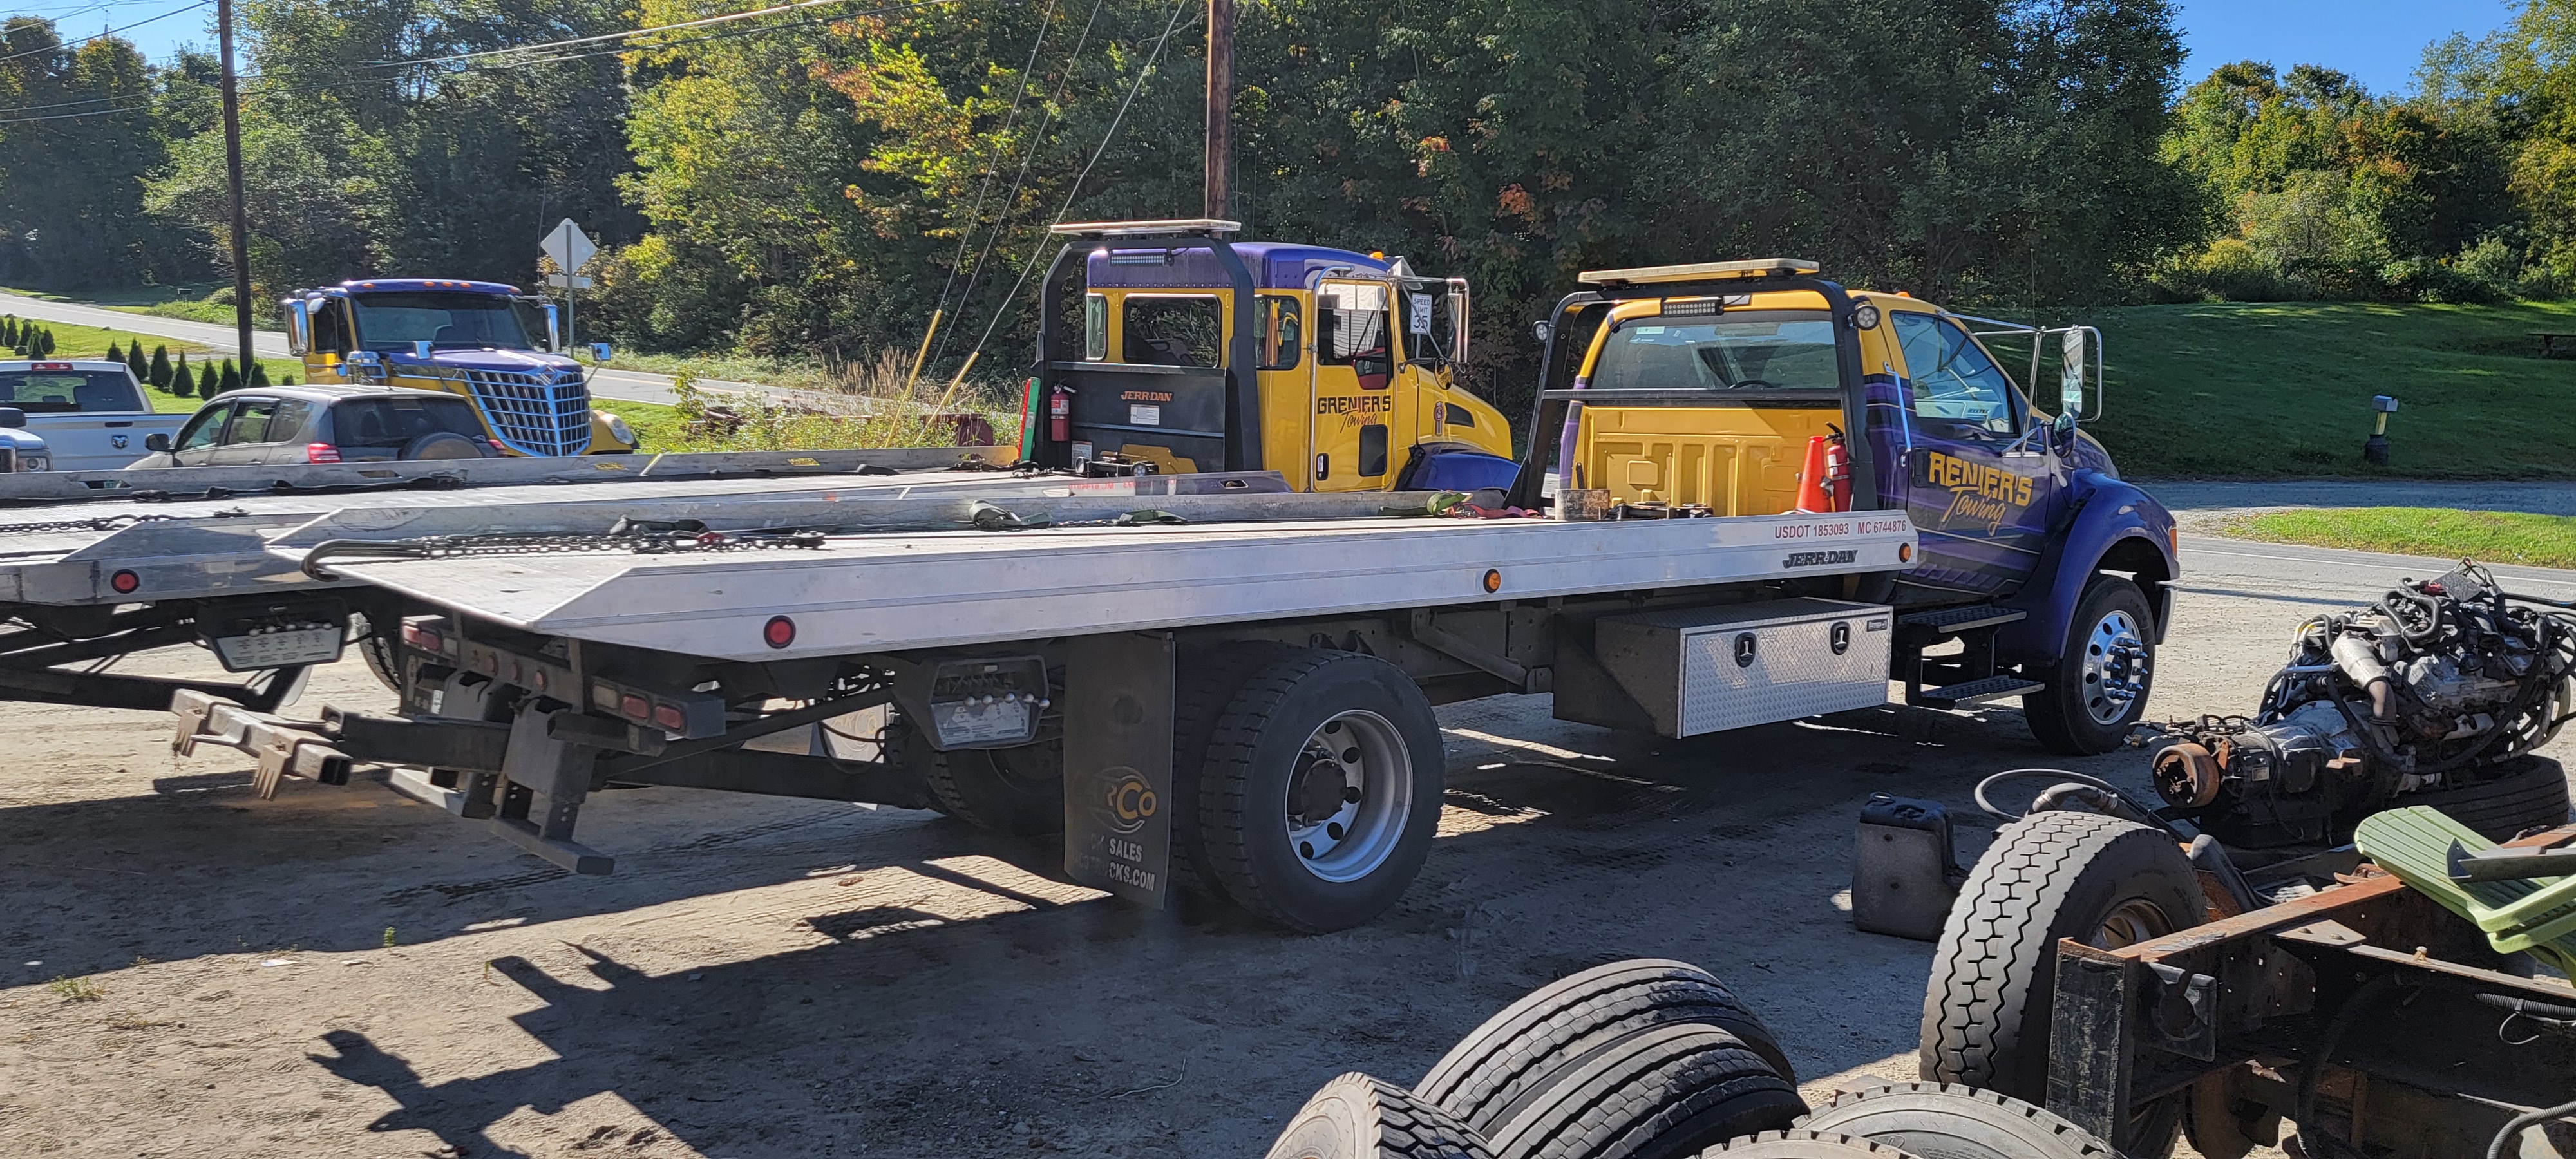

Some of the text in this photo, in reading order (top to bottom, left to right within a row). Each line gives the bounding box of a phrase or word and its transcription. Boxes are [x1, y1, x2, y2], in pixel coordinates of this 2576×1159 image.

[1414, 297, 1431, 306] SPEED
[1413, 314, 1428, 330] 35
[1317, 395, 1391, 415] GRENIER'S
[1940, 485, 2007, 536] Towing
[1775, 520, 1906, 538] USDOT 1853093 MC 6744876
[1109, 838, 1142, 863] SALES
[1108, 862, 1155, 891] CKS.COM
